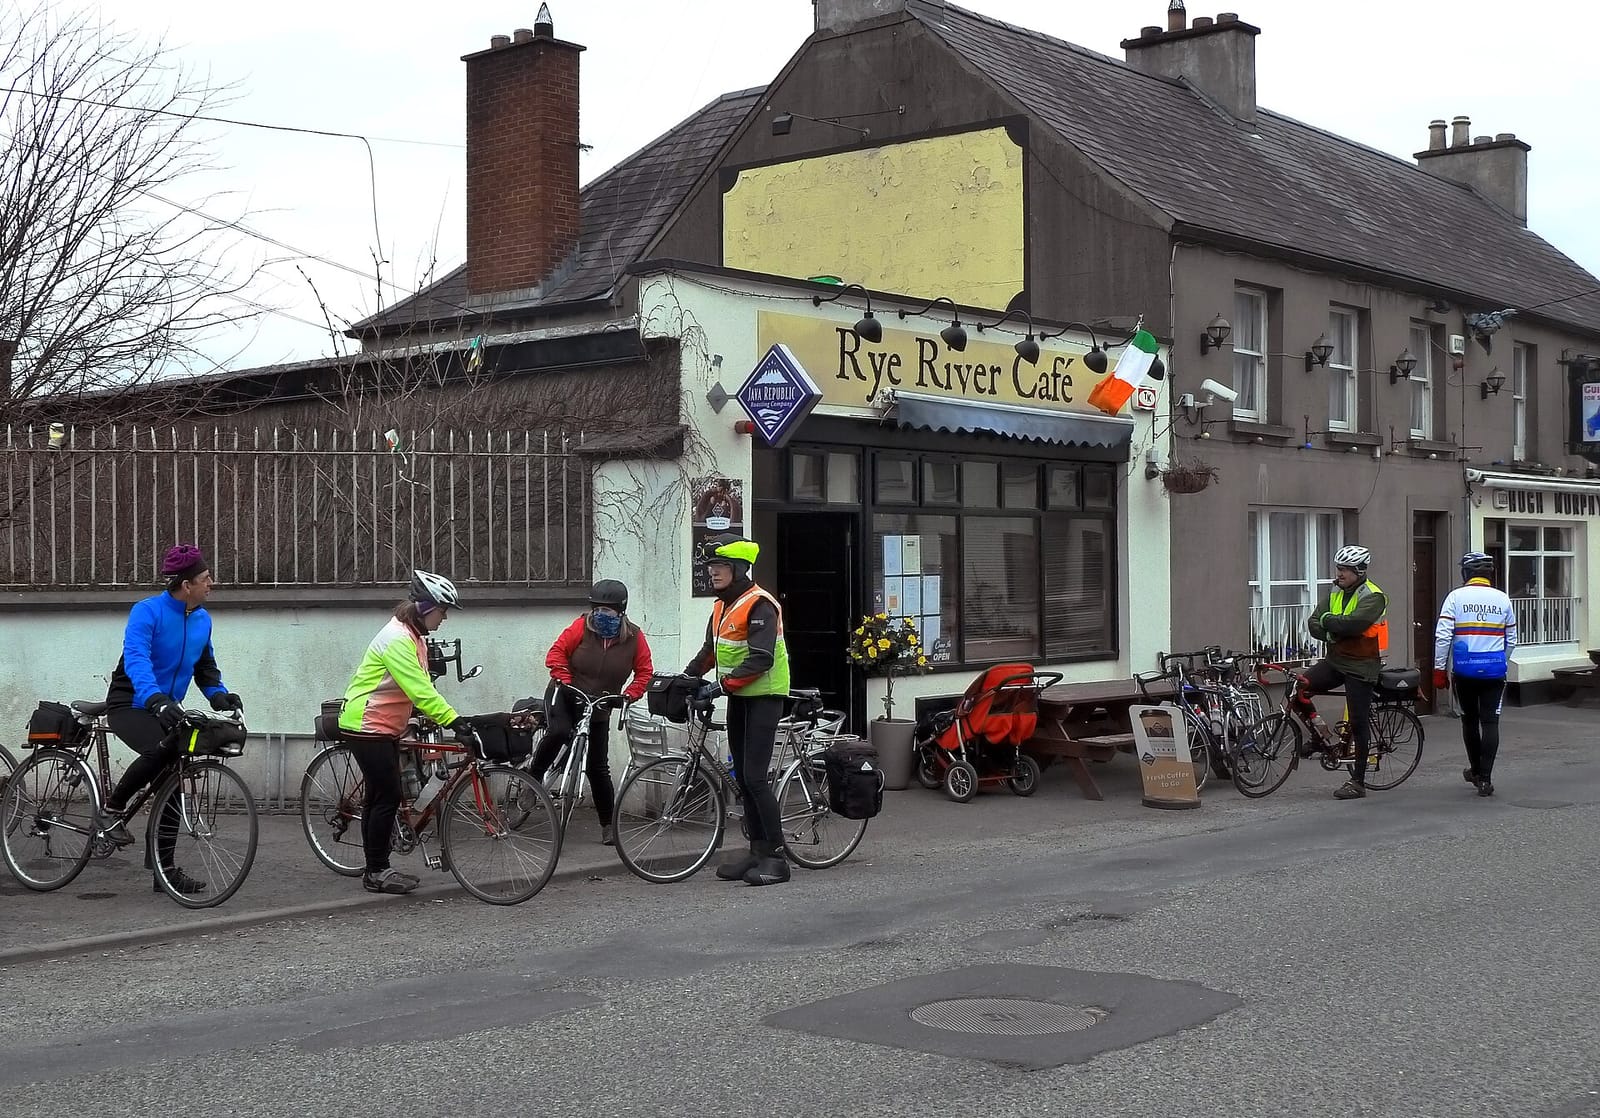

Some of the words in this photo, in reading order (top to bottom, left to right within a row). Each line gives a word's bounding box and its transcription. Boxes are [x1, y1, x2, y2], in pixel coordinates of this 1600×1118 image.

[836, 327, 901, 402] Rye
[915, 337, 1001, 395] River
[1012, 353, 1074, 403] Café
[747, 387, 762, 401] JAVA
[764, 386, 796, 401] REPUBLIC
[1509, 490, 1544, 514] HUGH
[1463, 604, 1503, 615] DROMARA
[1477, 612, 1487, 622] CC
[933, 652, 950, 661] OPEN
[1146, 773, 1166, 781] Fresh
[1166, 771, 1190, 779] Coffee
